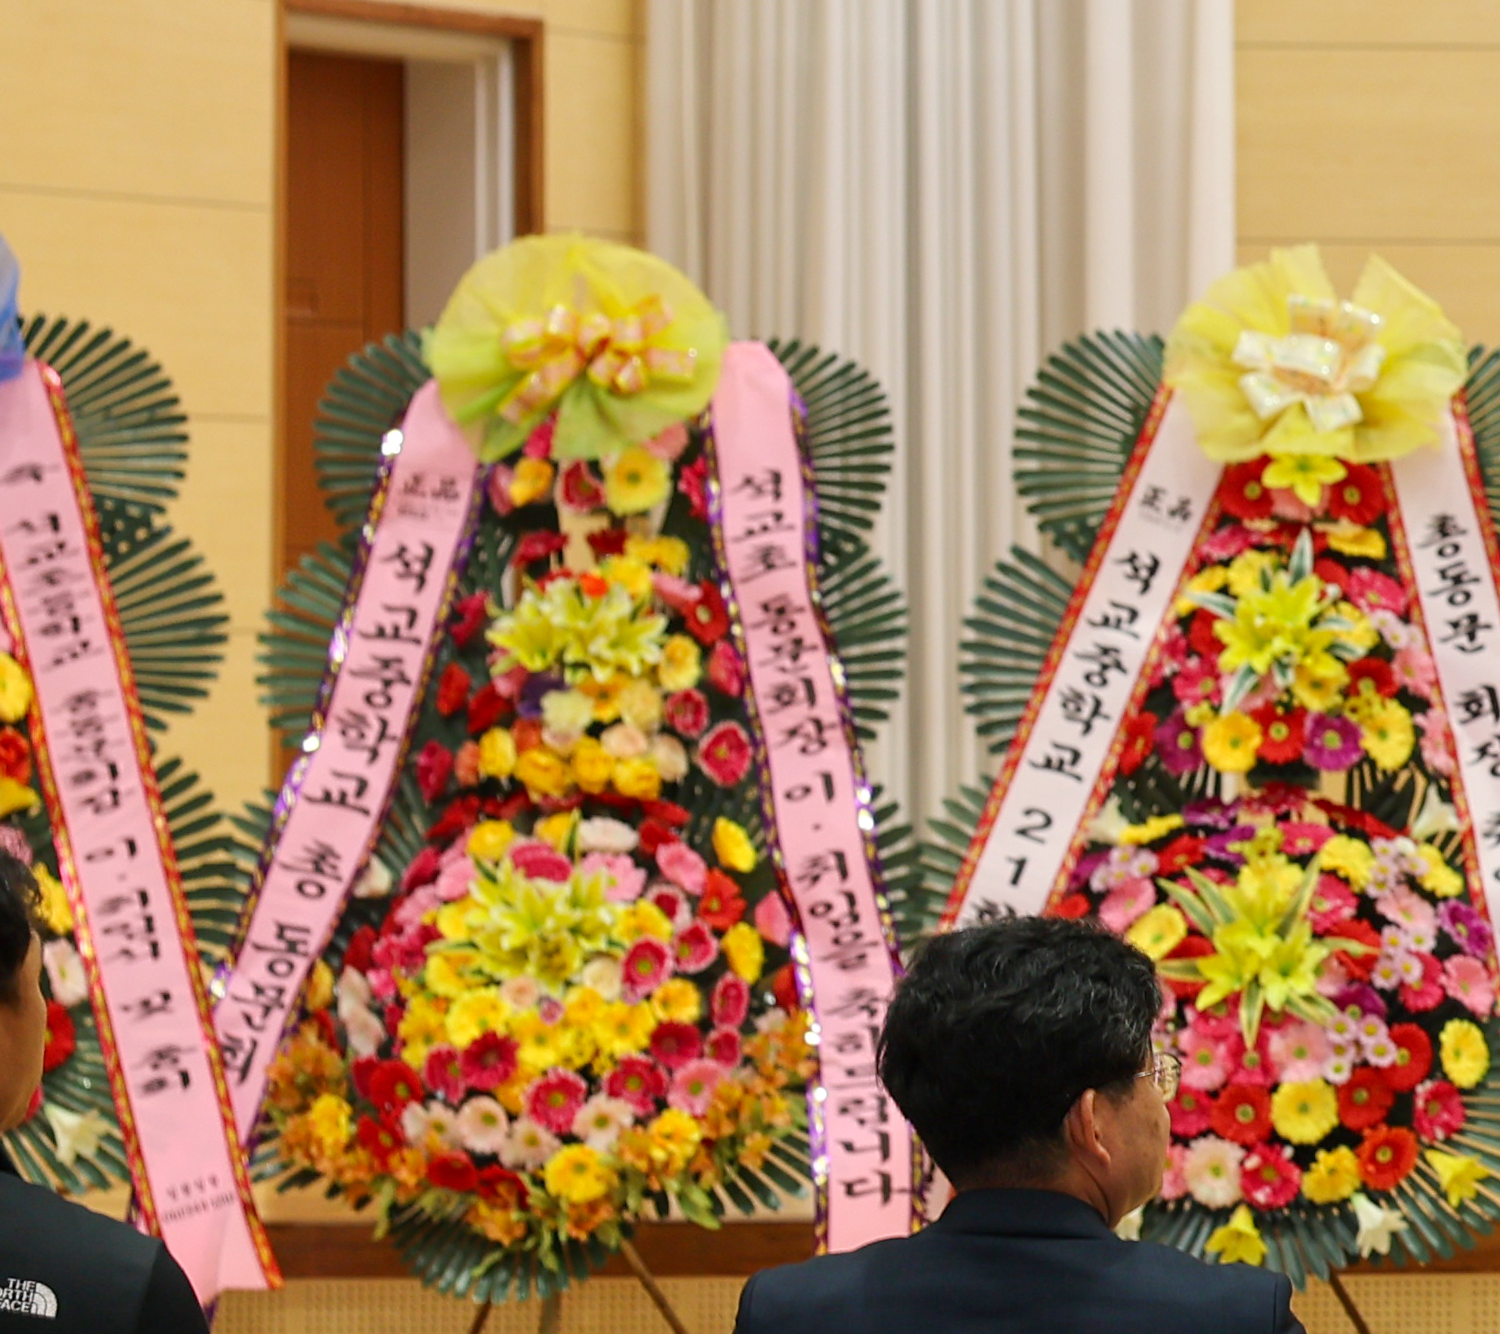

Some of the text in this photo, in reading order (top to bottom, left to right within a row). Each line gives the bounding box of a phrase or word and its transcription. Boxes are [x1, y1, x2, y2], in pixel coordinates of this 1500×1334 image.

[302, 538, 436, 819] 석교중학교
[1026, 548, 1163, 784] 석교중학교
[7, 1276, 37, 1292] THE
